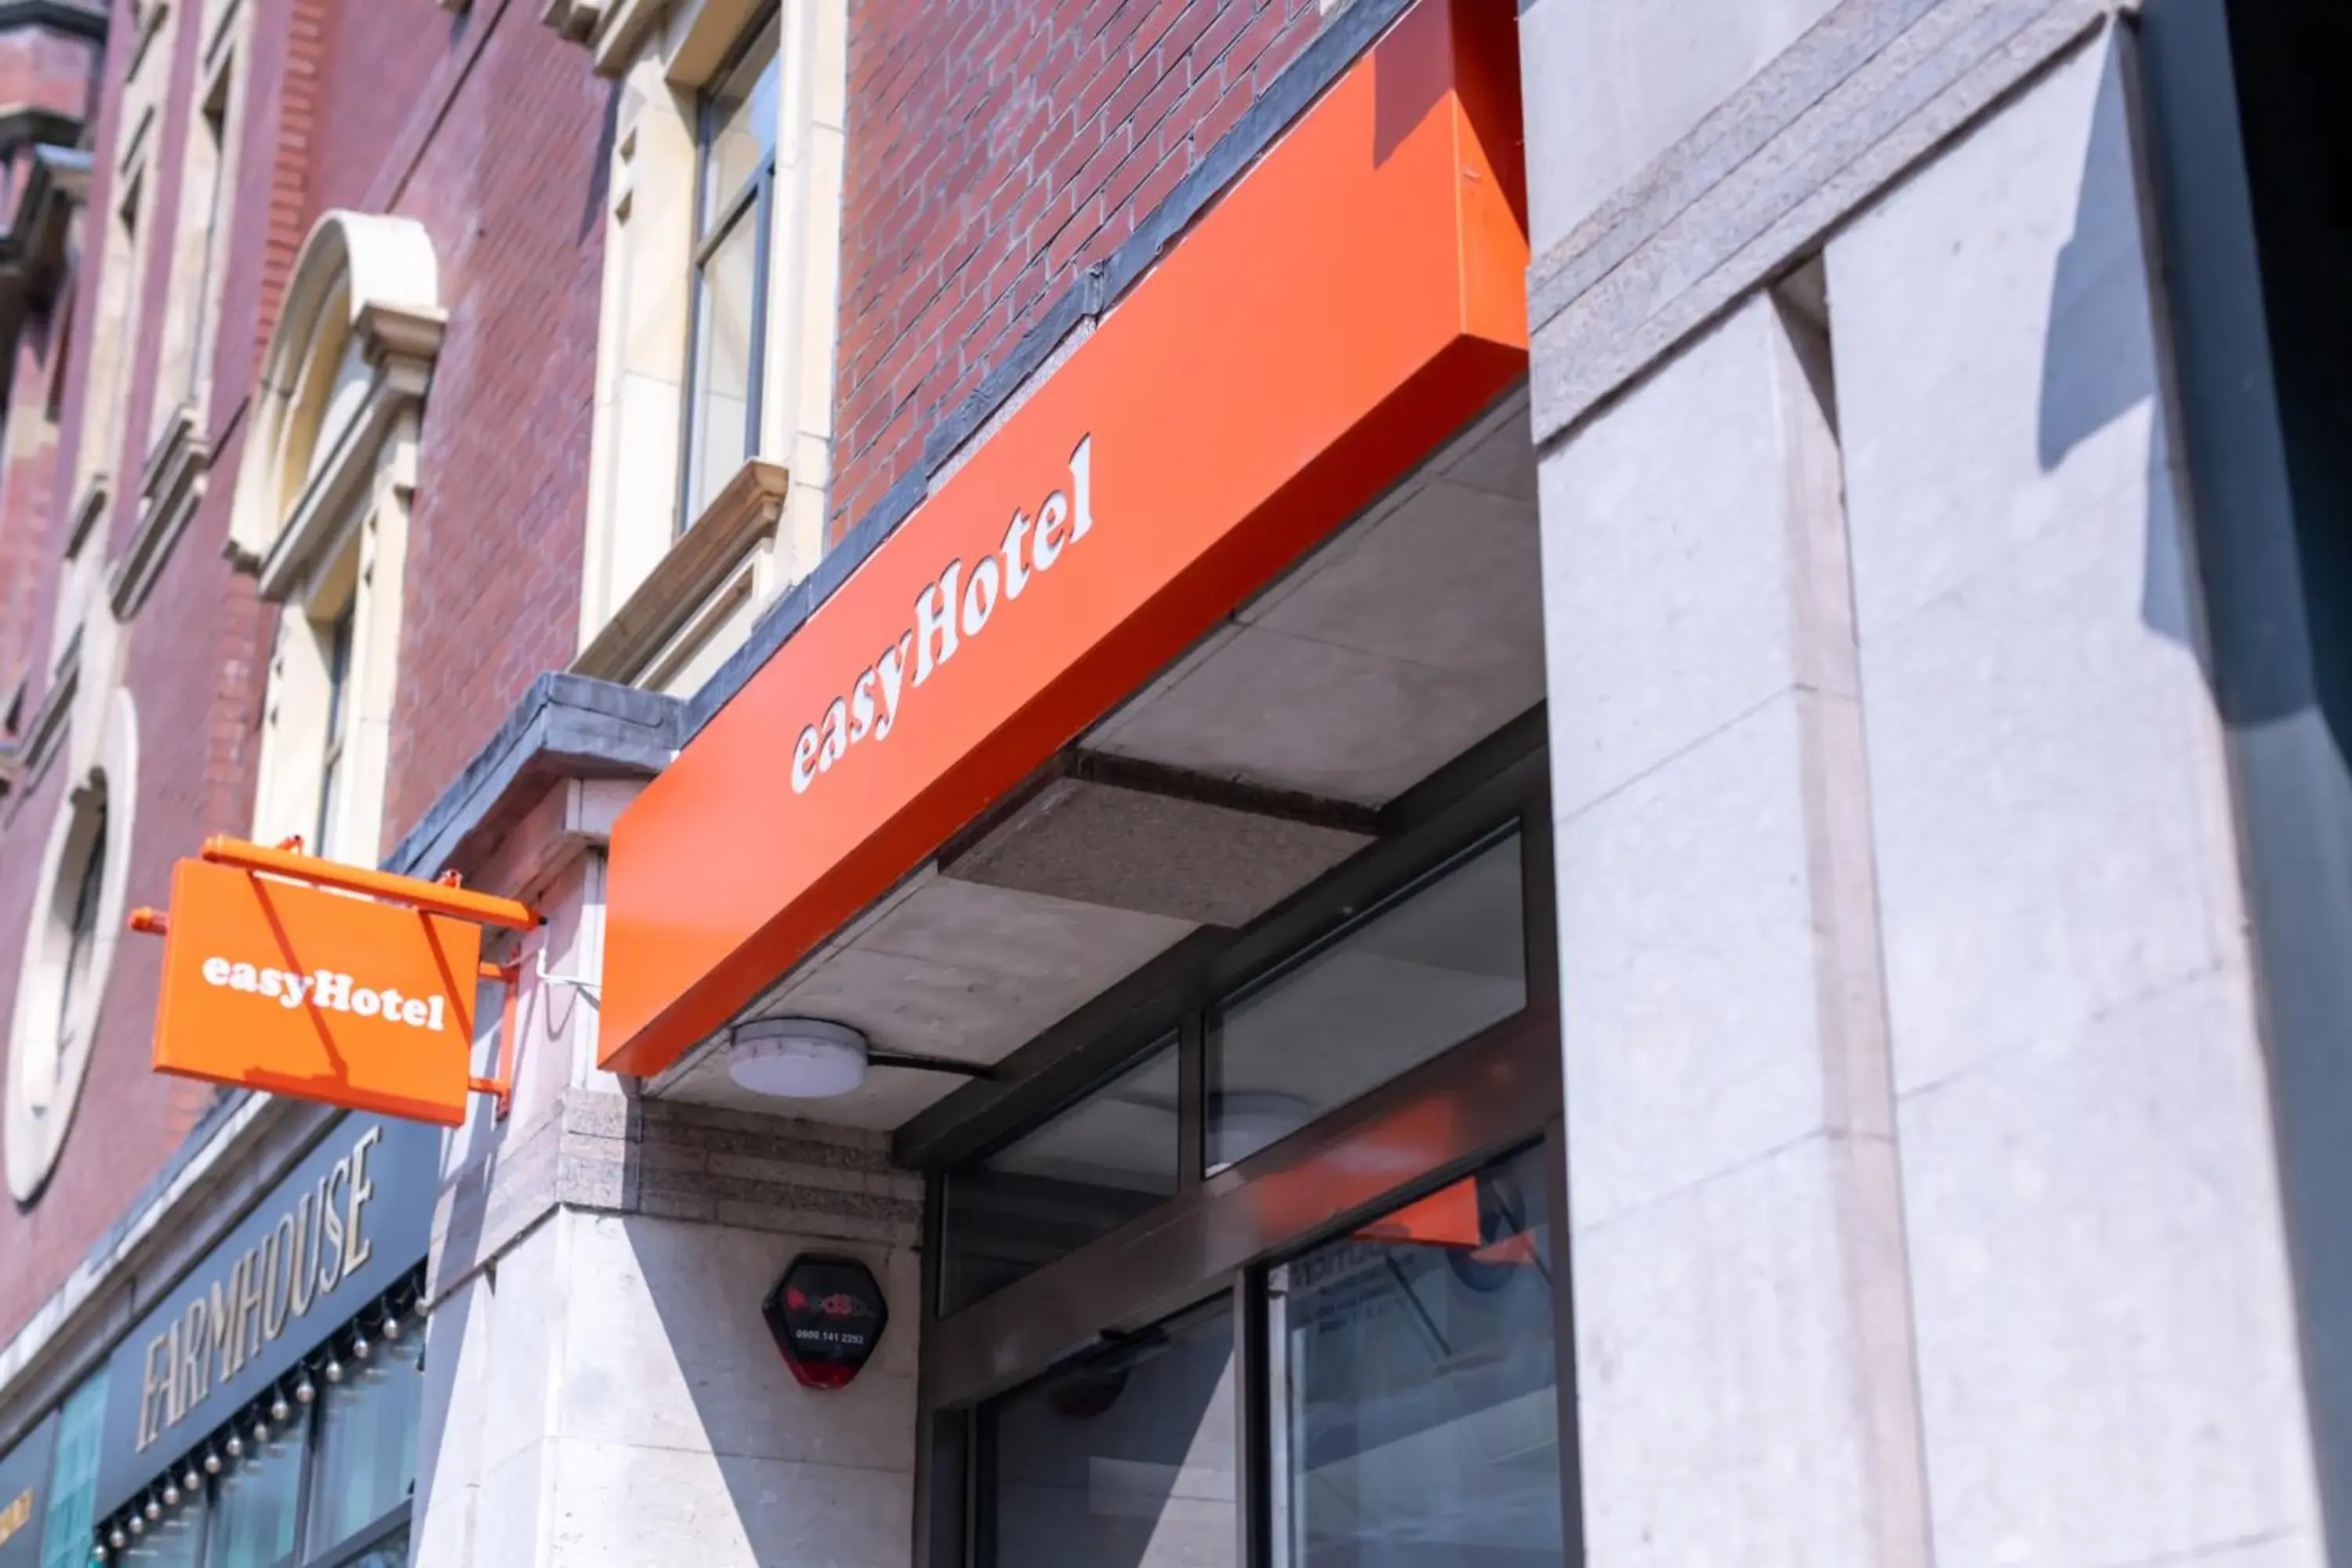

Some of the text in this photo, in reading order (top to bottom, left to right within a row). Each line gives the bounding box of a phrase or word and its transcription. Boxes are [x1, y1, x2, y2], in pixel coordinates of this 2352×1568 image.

[791, 432, 1093, 794] easyHotel
[201, 956, 445, 1031] easyHotel
[136, 1124, 382, 1454] FARMHOUSE
